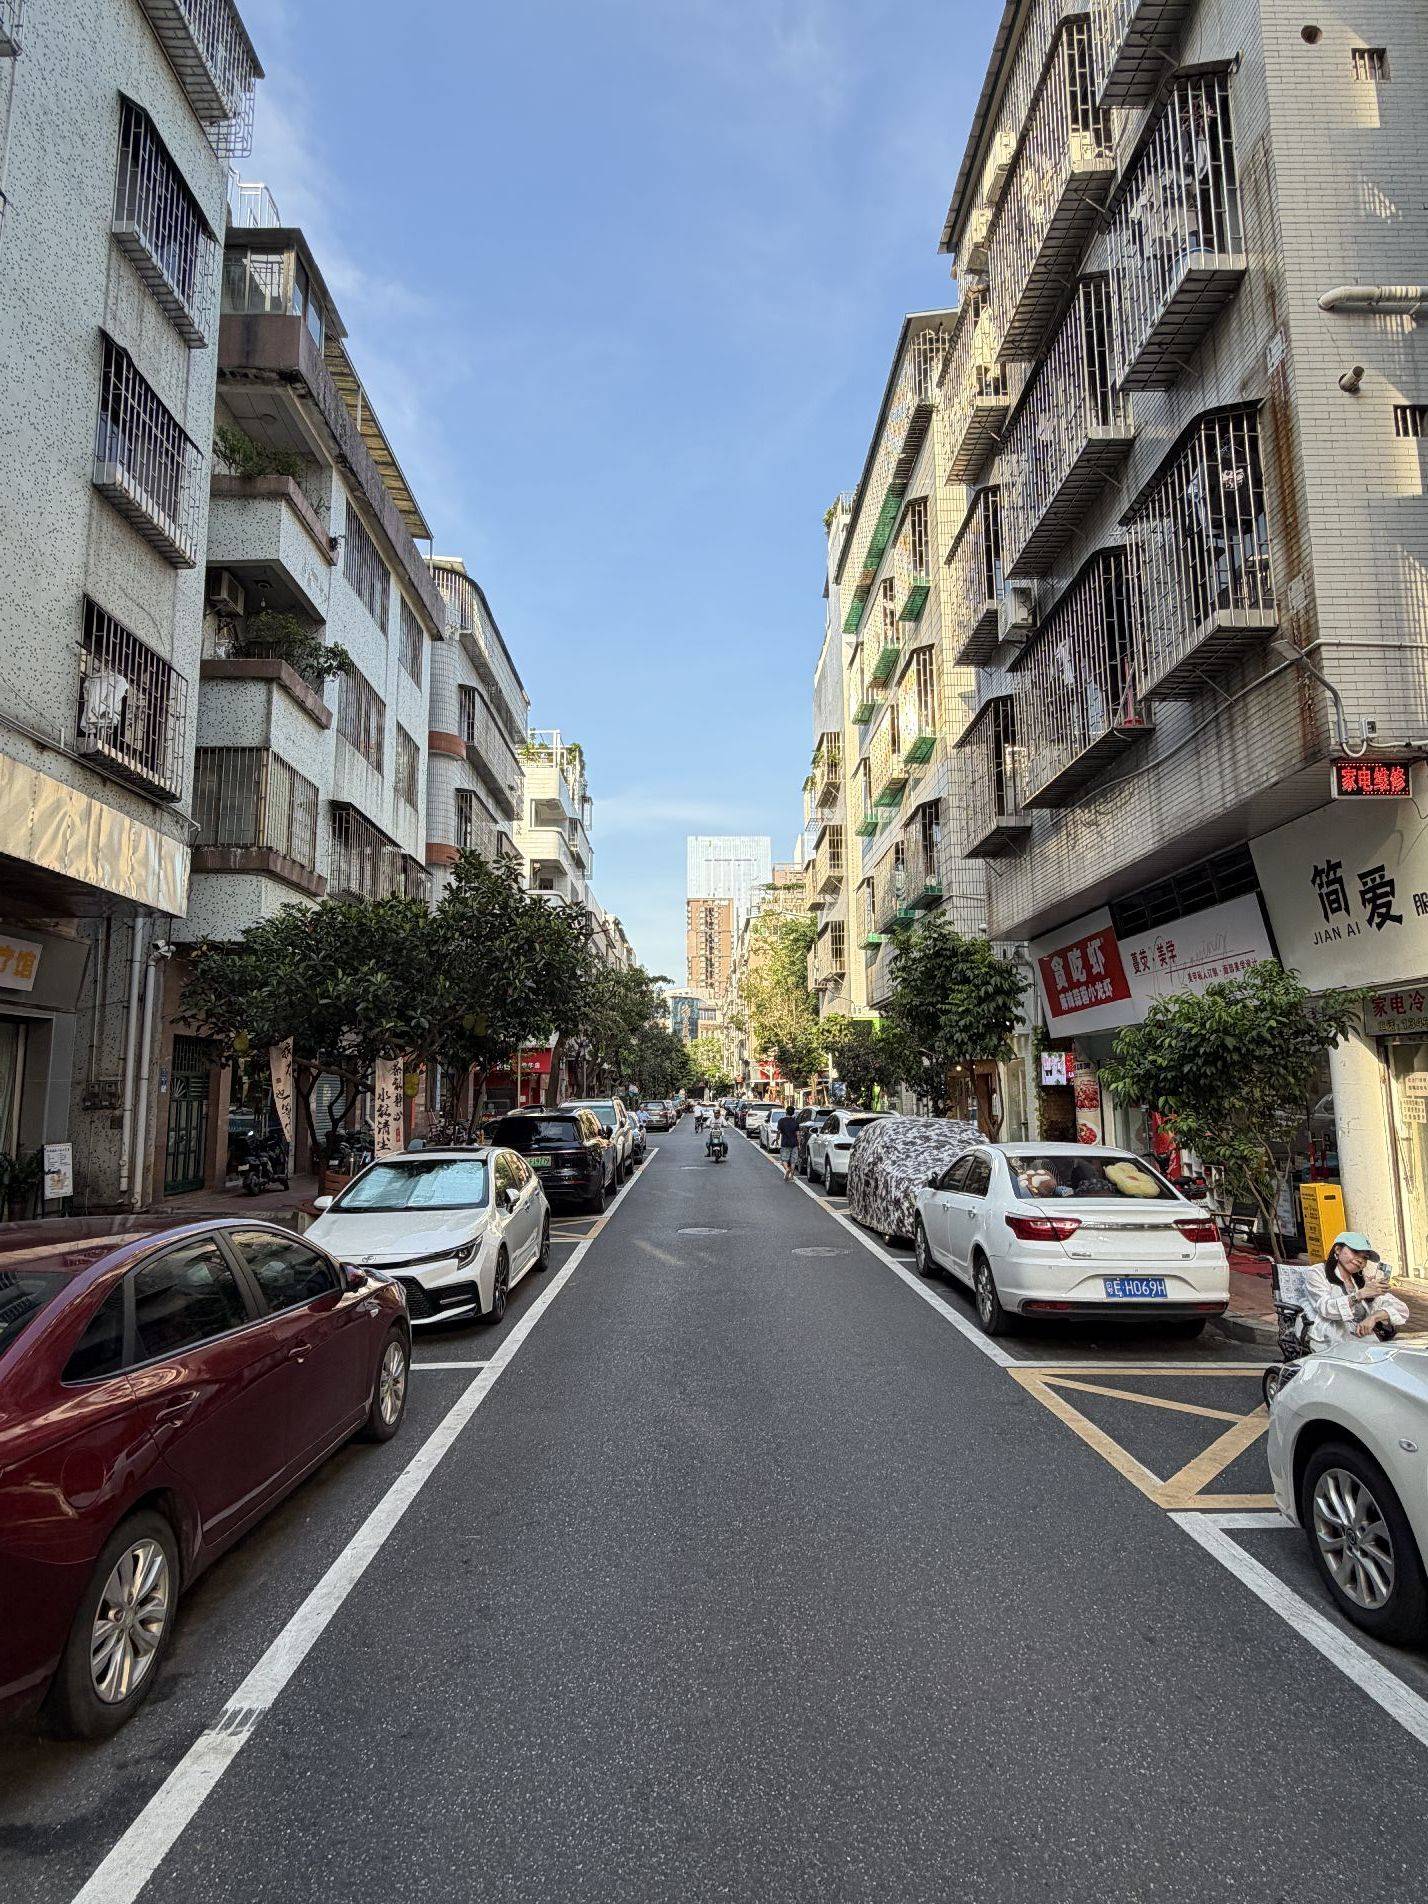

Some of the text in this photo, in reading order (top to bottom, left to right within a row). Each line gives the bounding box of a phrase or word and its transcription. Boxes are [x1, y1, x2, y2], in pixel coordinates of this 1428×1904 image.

[1341, 767, 1406, 792] 家电维修
[1311, 859, 1428, 932] 简爱 服
[1313, 921, 1361, 946] JIAN AI
[1050, 937, 1105, 991] 贪吃虾
[1371, 990, 1425, 1017] 家电冷
